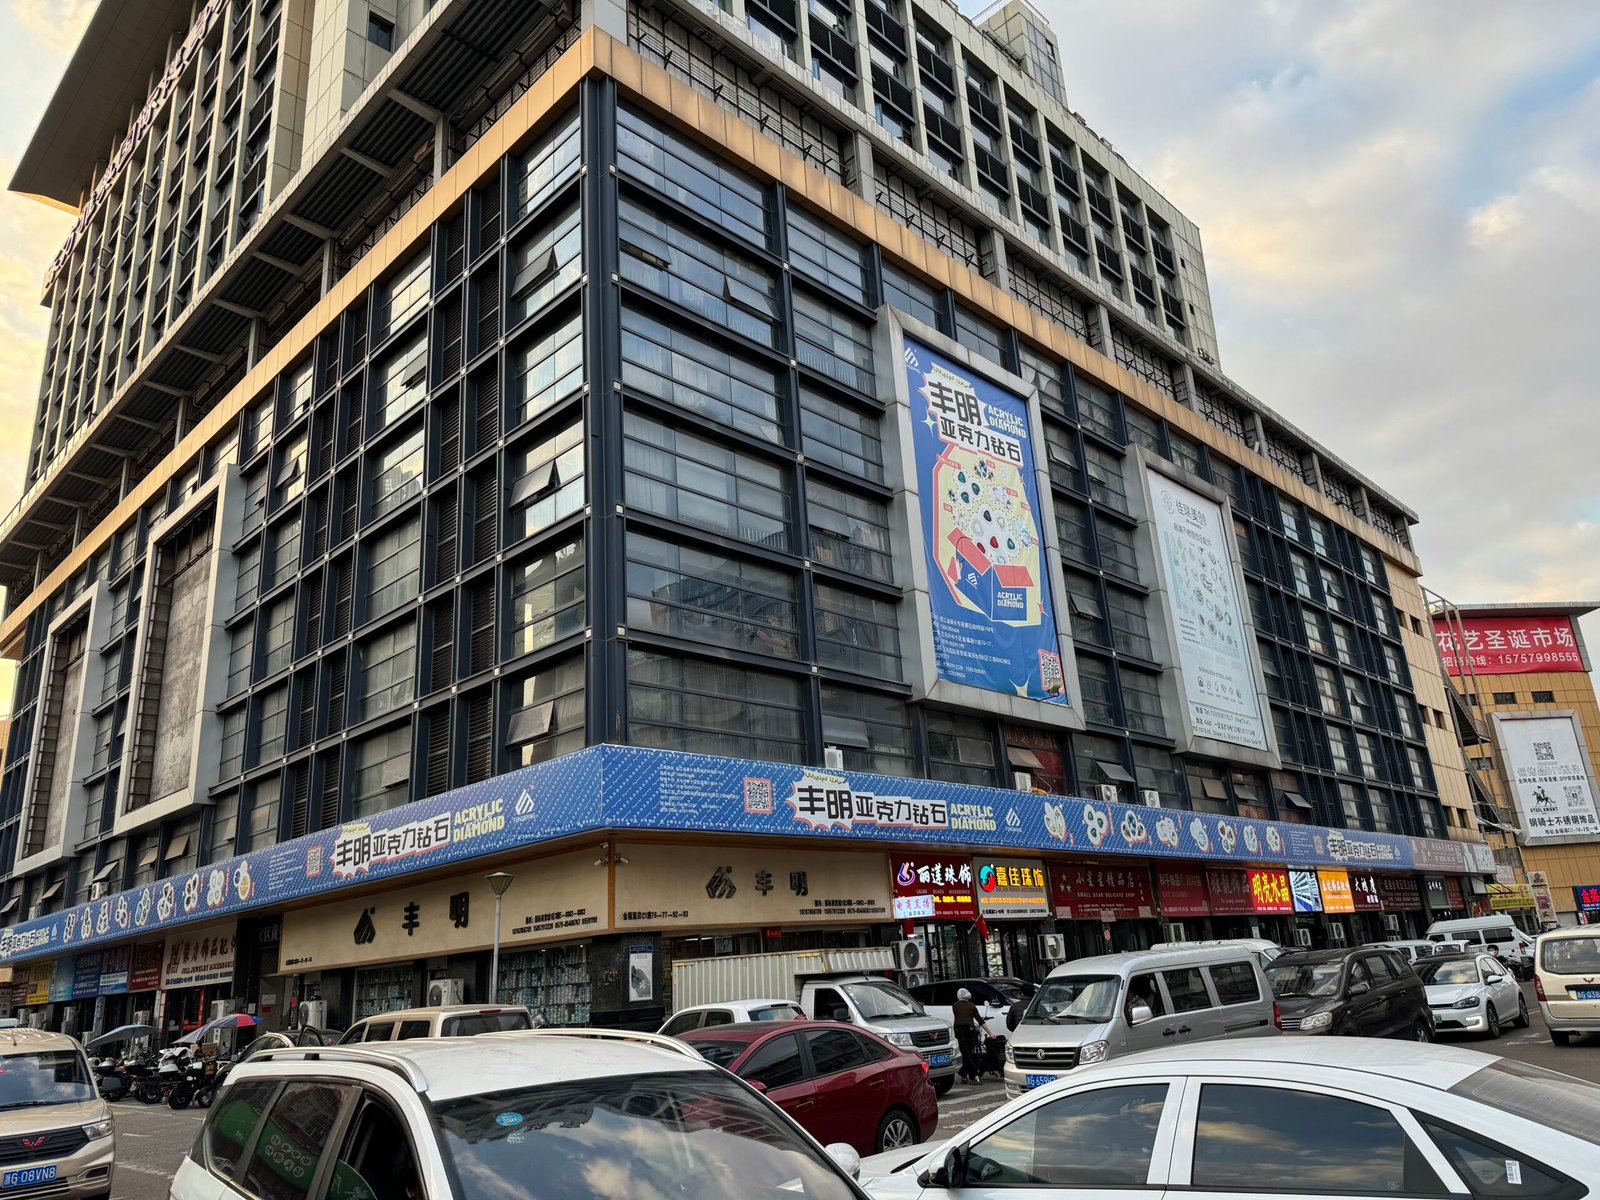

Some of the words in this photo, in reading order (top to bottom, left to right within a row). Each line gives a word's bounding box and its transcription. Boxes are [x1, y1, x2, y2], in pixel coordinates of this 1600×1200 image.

[928, 380, 982, 426] 丰明
[988, 405, 1023, 427] ACRYLIC
[989, 416, 1026, 438] DIAMOND
[940, 416, 1021, 462] 亚克力钻石
[997, 592, 1023, 600] ACRYLIC
[997, 600, 1024, 609] DIAMOND
[1435, 627, 1573, 651] 花艺圣诞市场
[1497, 652, 1579, 664] 15757998555
[454, 799, 504, 826] ACRYLIC
[797, 785, 946, 826] 丰明亚克力钻石
[950, 803, 993, 818] ACRYLIC
[453, 815, 505, 843] DIAMOND
[951, 817, 997, 832] DIAMOND
[337, 816, 450, 867] 丰明亚克力钻石
[995, 866, 1044, 887] 嘉佳珠饰
